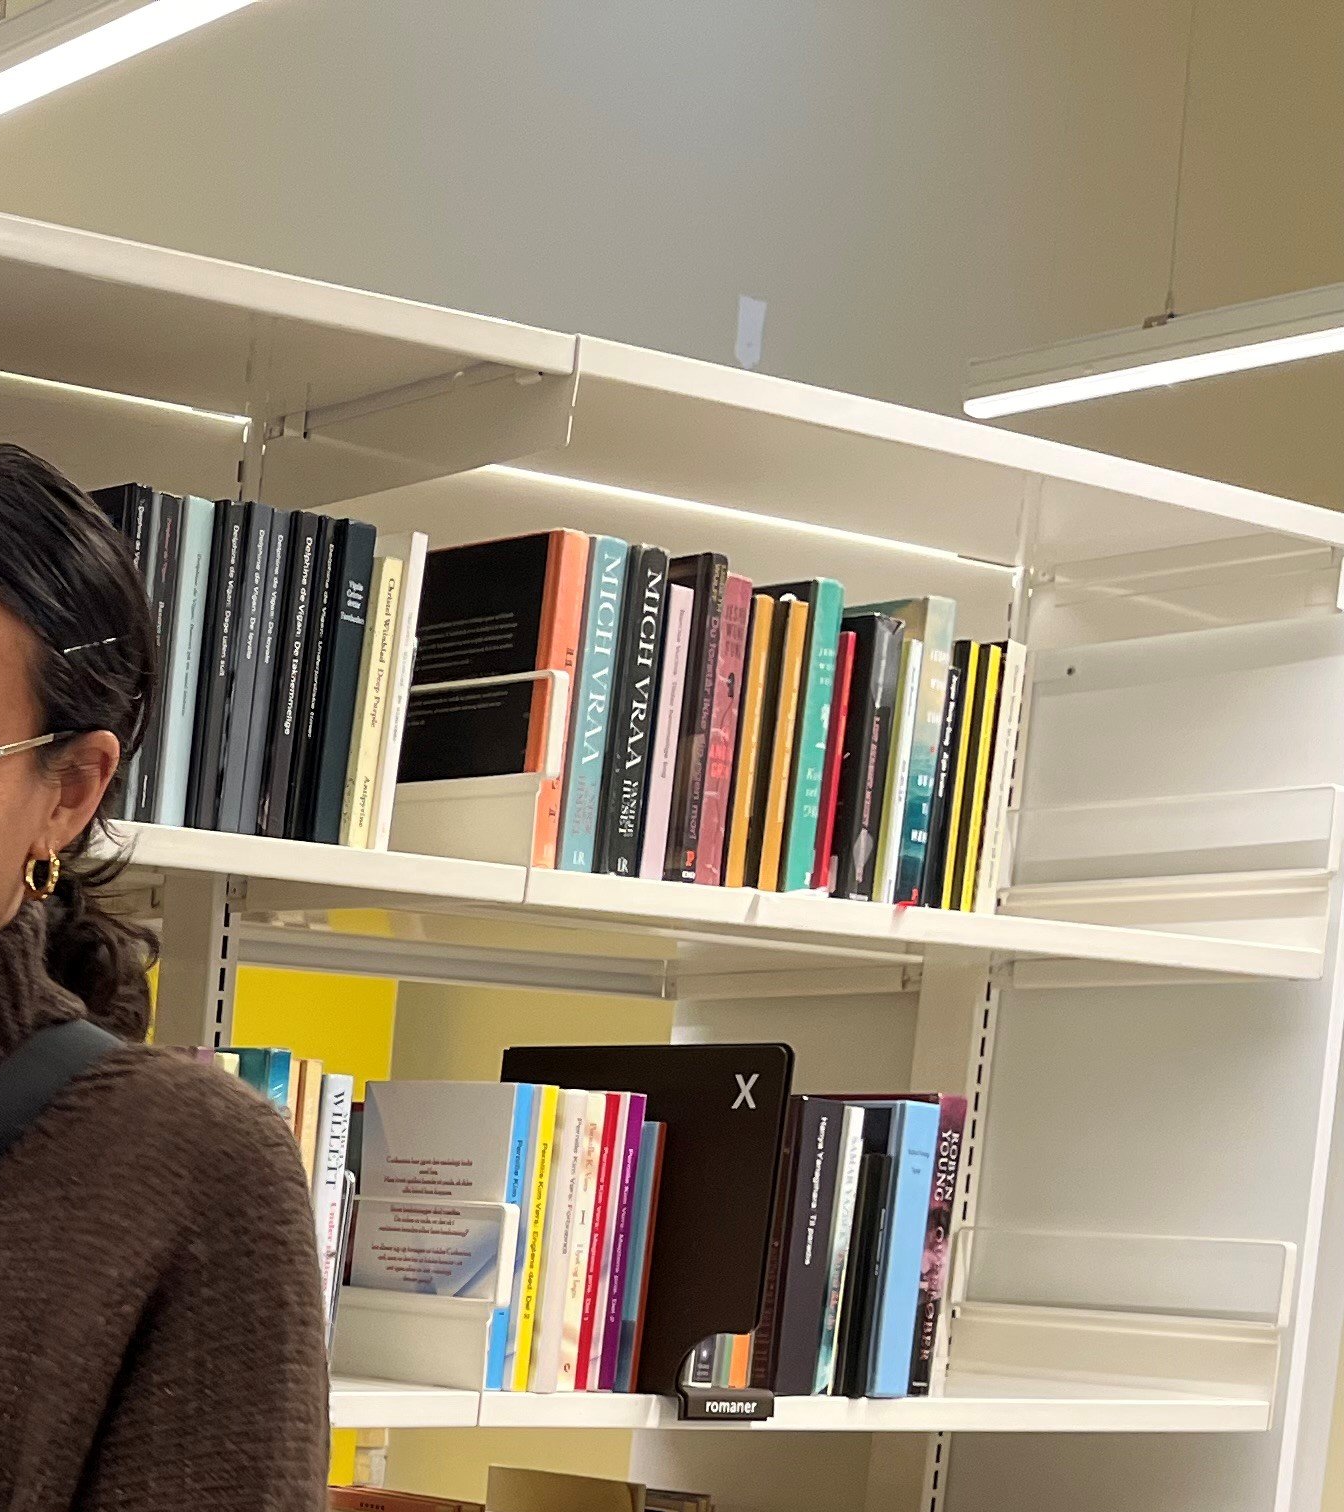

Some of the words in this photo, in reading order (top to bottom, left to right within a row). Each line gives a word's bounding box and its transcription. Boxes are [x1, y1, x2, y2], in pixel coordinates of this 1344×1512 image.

[594, 554, 622, 656] MICH
[581, 667, 610, 765] VRAA
[731, 1073, 759, 1109] X
[706, 1400, 757, 1413] romaner
